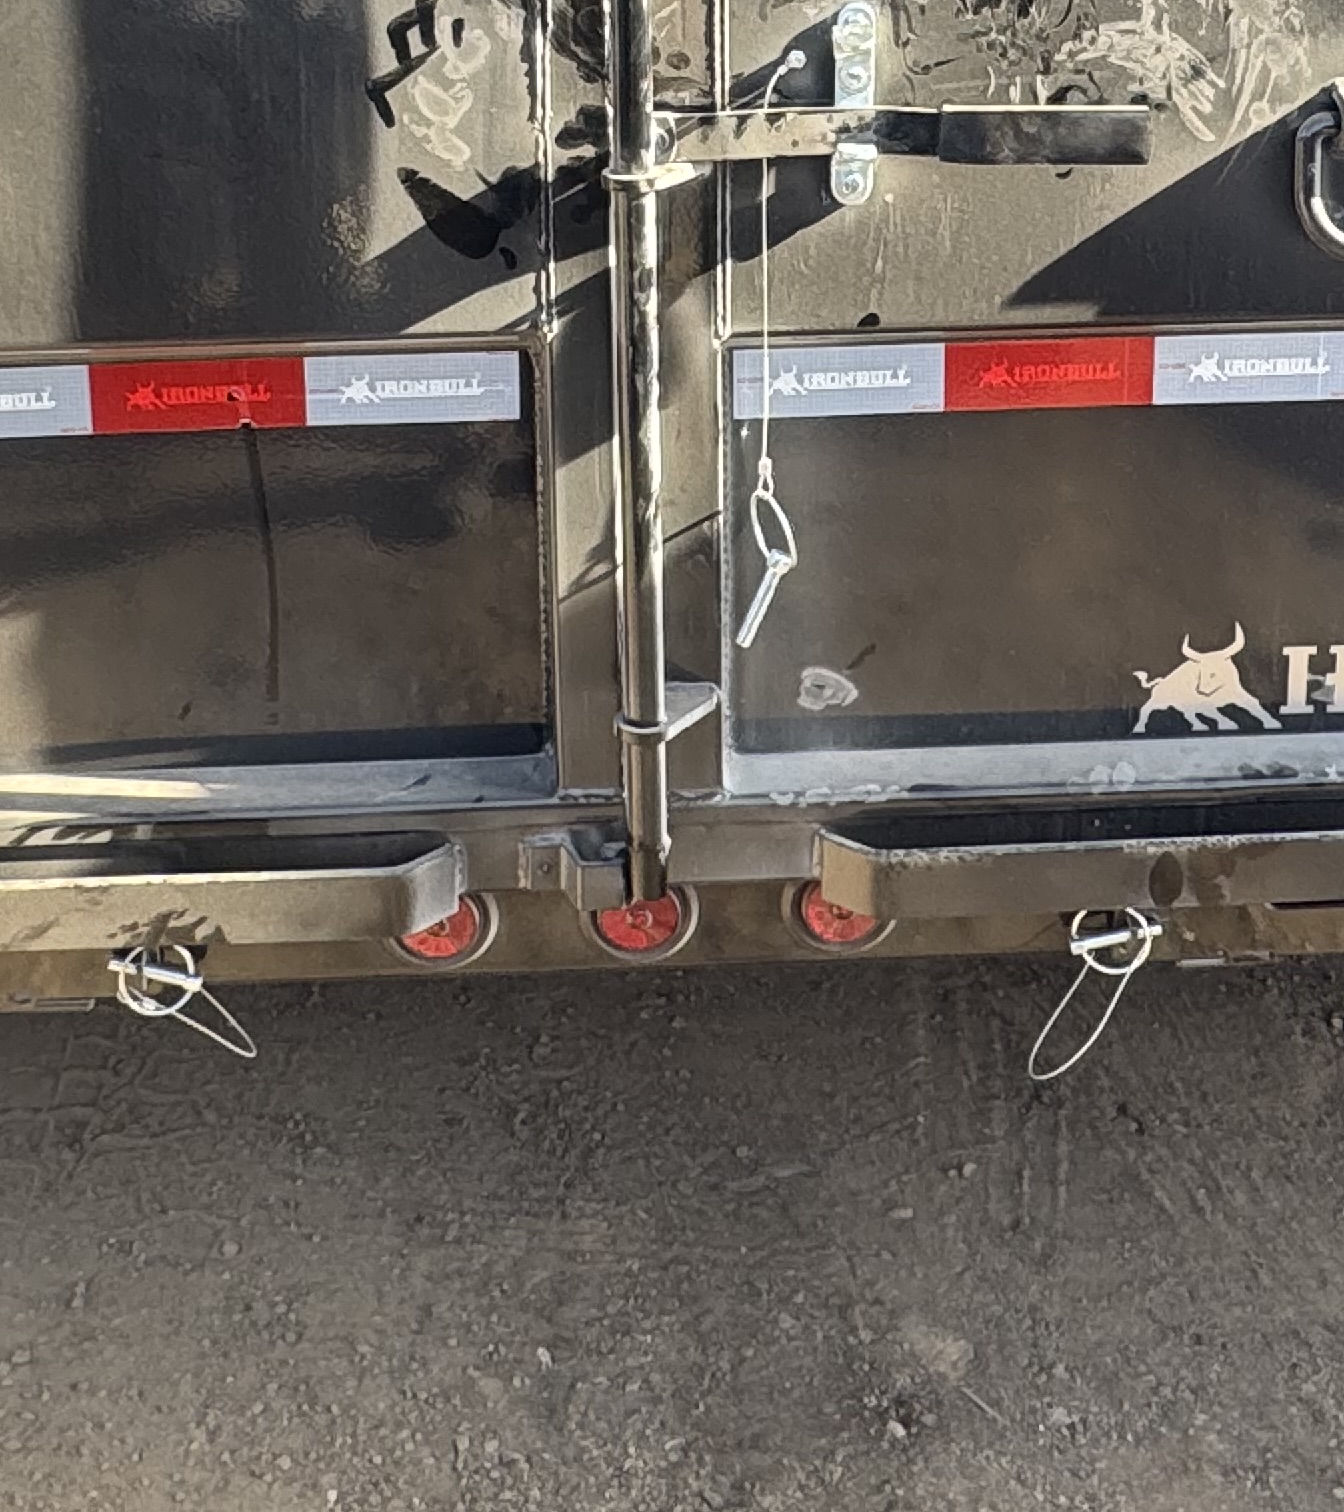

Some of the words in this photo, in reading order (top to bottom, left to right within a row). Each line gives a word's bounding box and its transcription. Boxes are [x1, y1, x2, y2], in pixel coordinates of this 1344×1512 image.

[803, 364, 911, 389] IRONBULL
[1014, 361, 1120, 383] IRONBULL
[1224, 351, 1331, 377] IRONBULL
[161, 381, 272, 405] IRONBLL
[375, 372, 486, 397] IRONBULL
